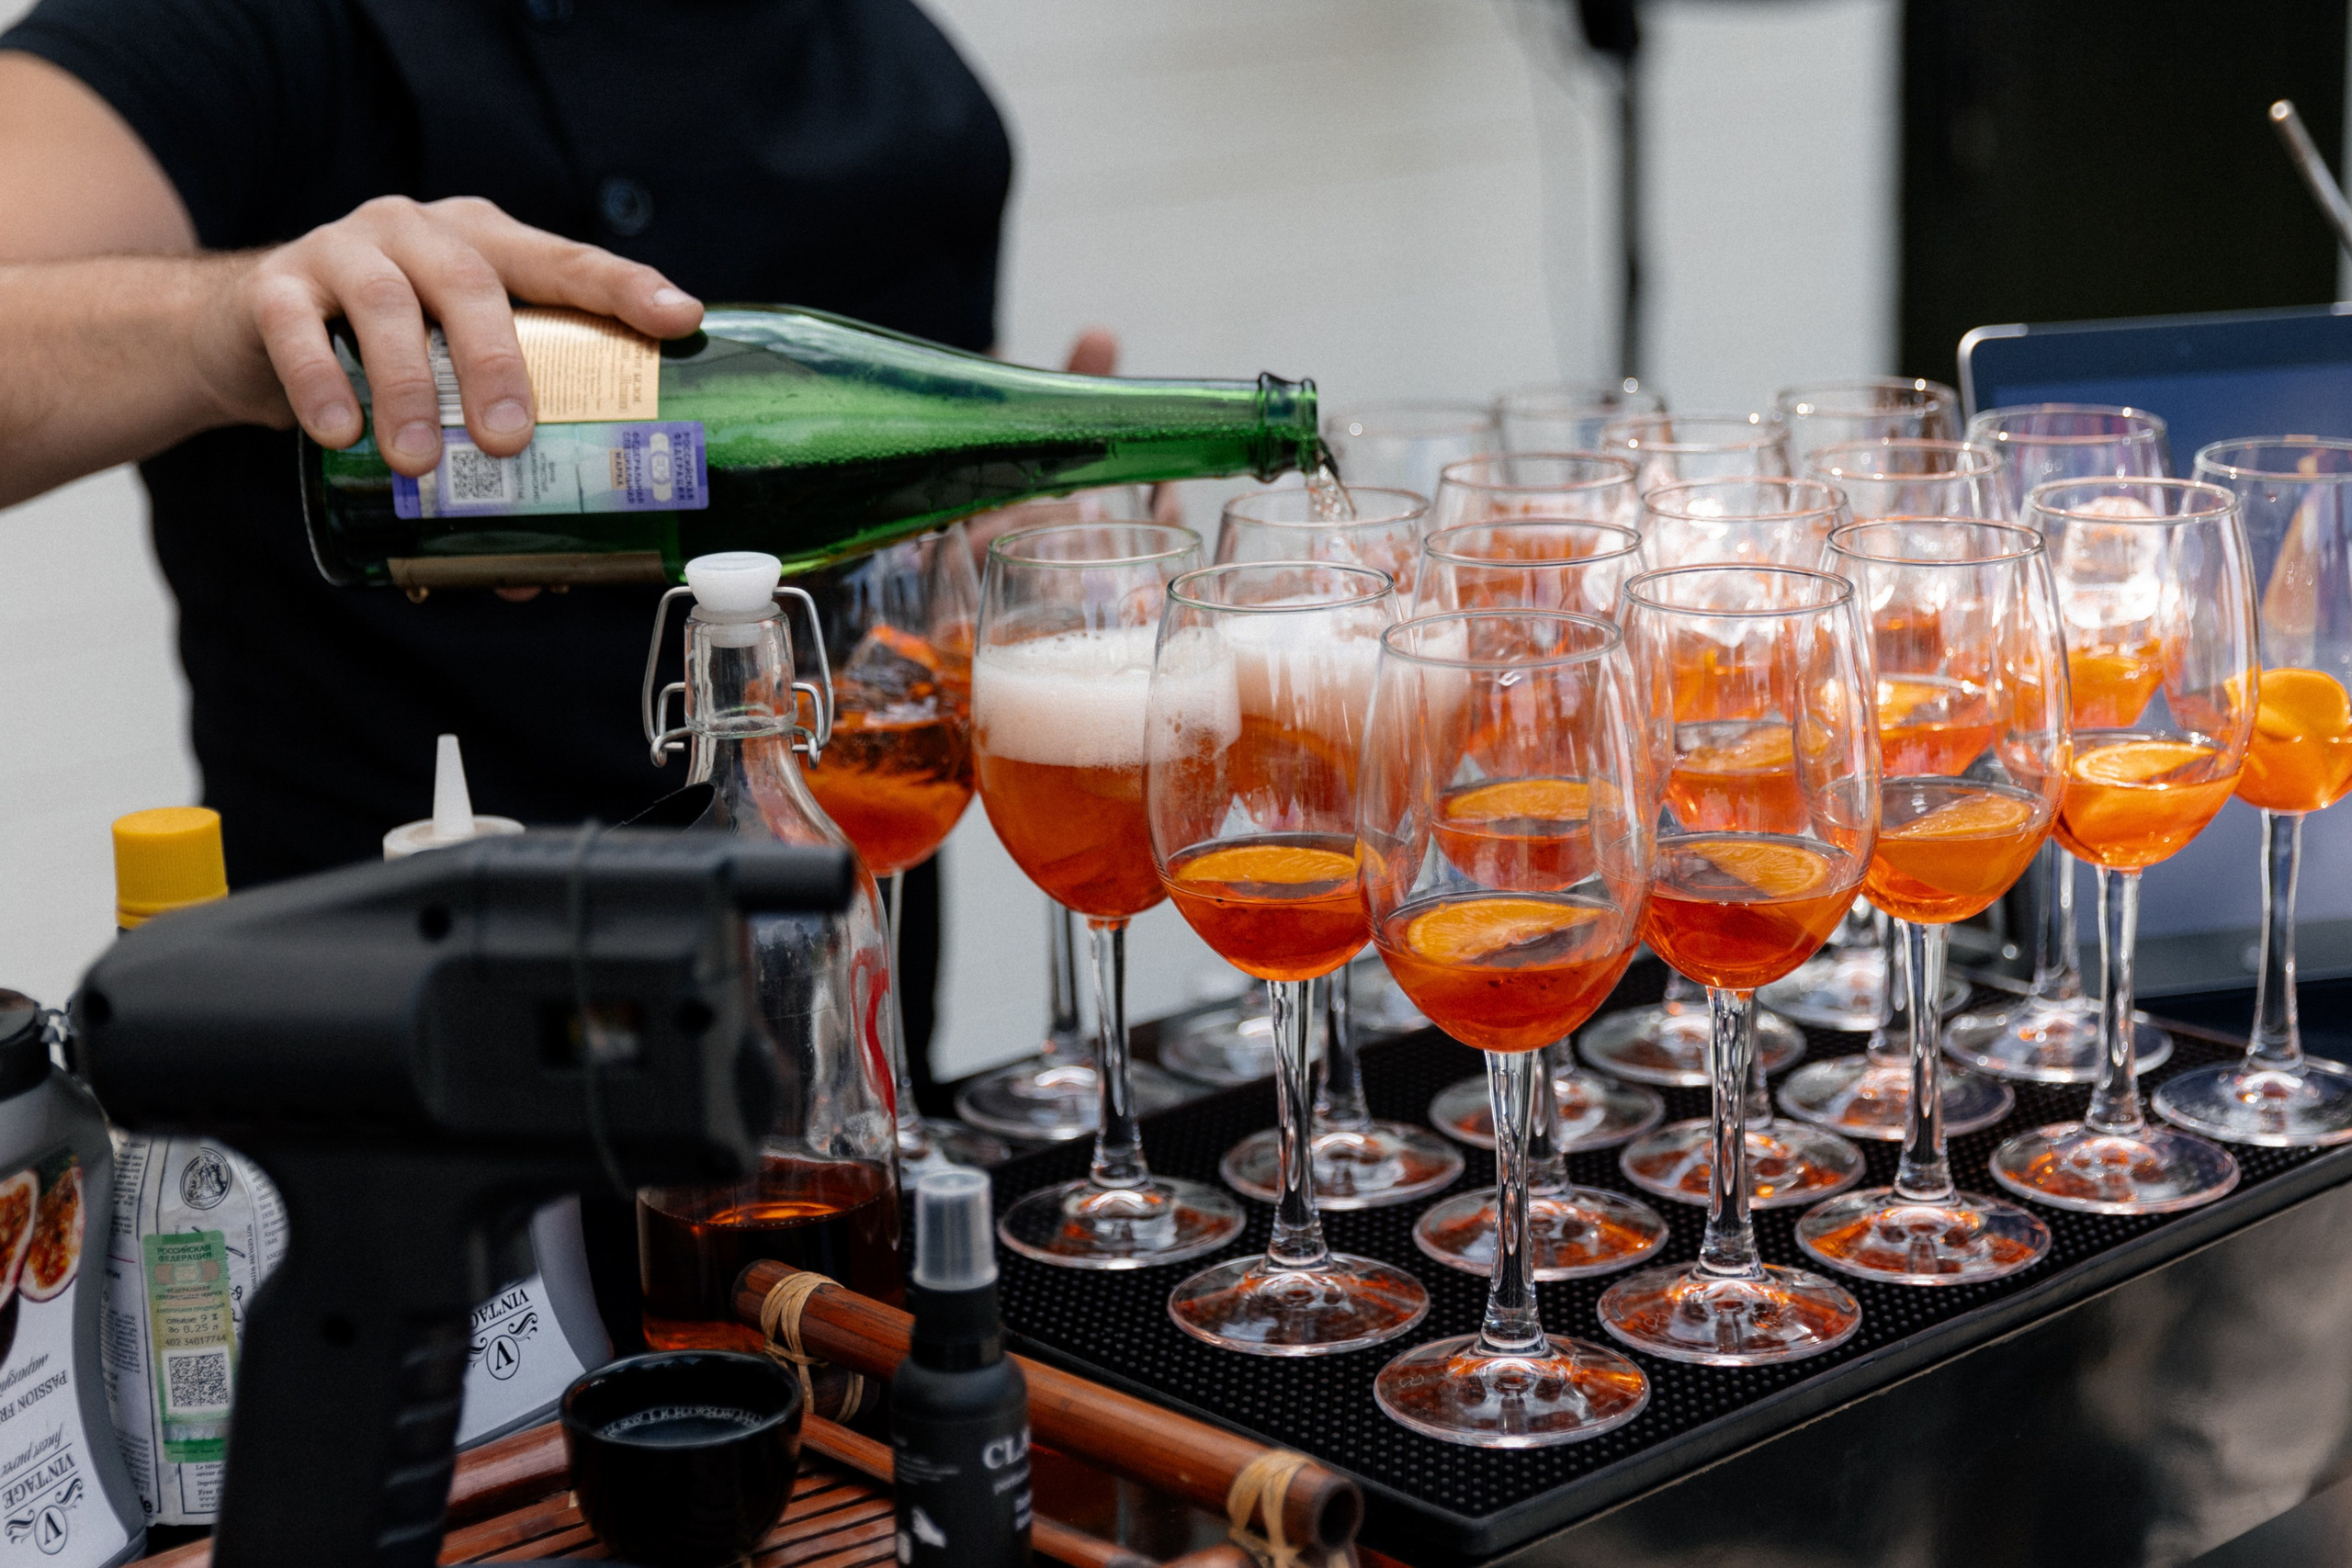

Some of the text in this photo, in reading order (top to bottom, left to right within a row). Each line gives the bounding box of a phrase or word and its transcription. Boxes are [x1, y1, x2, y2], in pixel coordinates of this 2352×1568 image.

[673, 432, 685, 502] ФЕДЕРАЦИЯ
[683, 432, 695, 502] РОССИЙСКАЯ
[157, 1244, 211, 1255] РОССИЙСКАЯ
[158, 1252, 212, 1262] ФЕДЕРАЦИЯ
[247, 1238, 255, 1265] GENUINE
[165, 1314, 197, 1324] свыше
[199, 1314, 208, 1322] 9
[495, 1340, 514, 1371] V
[17, 1370, 68, 1413] PASSION
[0, 1402, 16, 1426] FR
[32, 1422, 64, 1459] finest
[2, 1453, 75, 1510] VIN'TAGE
[43, 1511, 63, 1545] V
